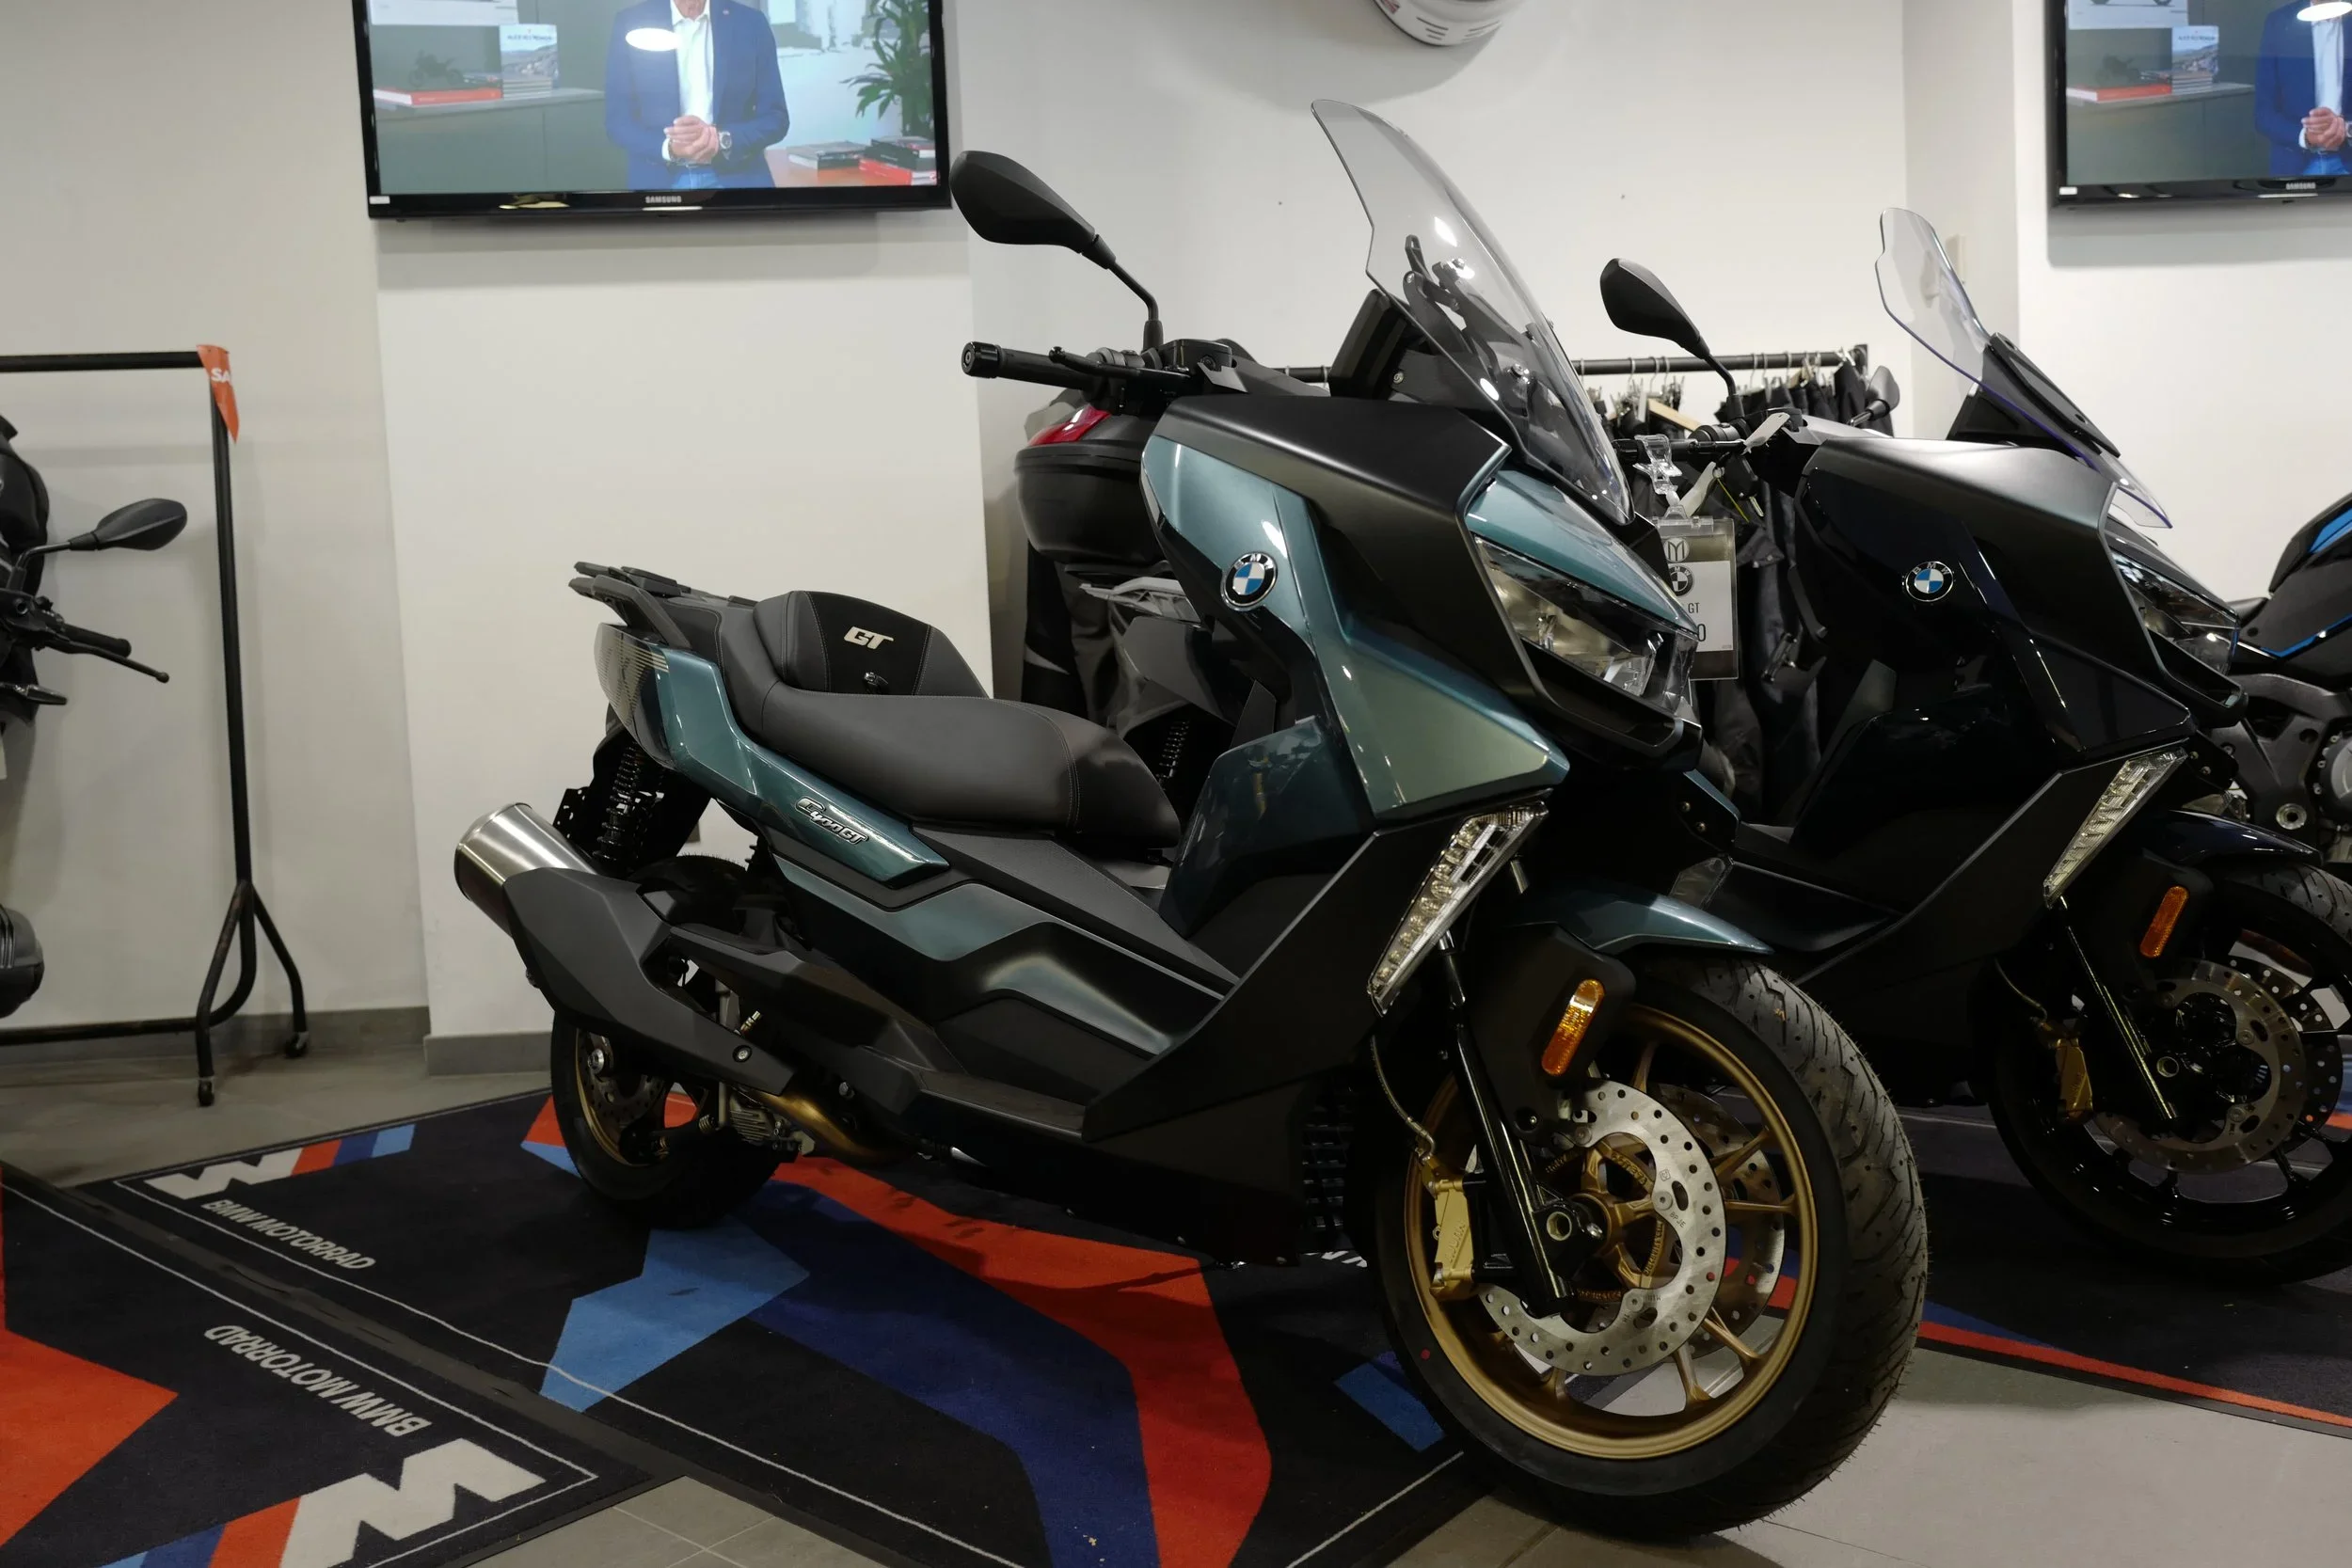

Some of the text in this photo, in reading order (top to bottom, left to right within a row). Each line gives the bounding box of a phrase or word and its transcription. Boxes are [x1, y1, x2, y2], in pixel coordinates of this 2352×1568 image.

[645, 195, 682, 204] SAMSUNG
[1688, 602, 1700, 614] GT
[843, 626, 895, 650] GT
[200, 1198, 377, 1270] BMW MOTORRAD
[203, 1324, 433, 1437] BMW MOTORRAD
